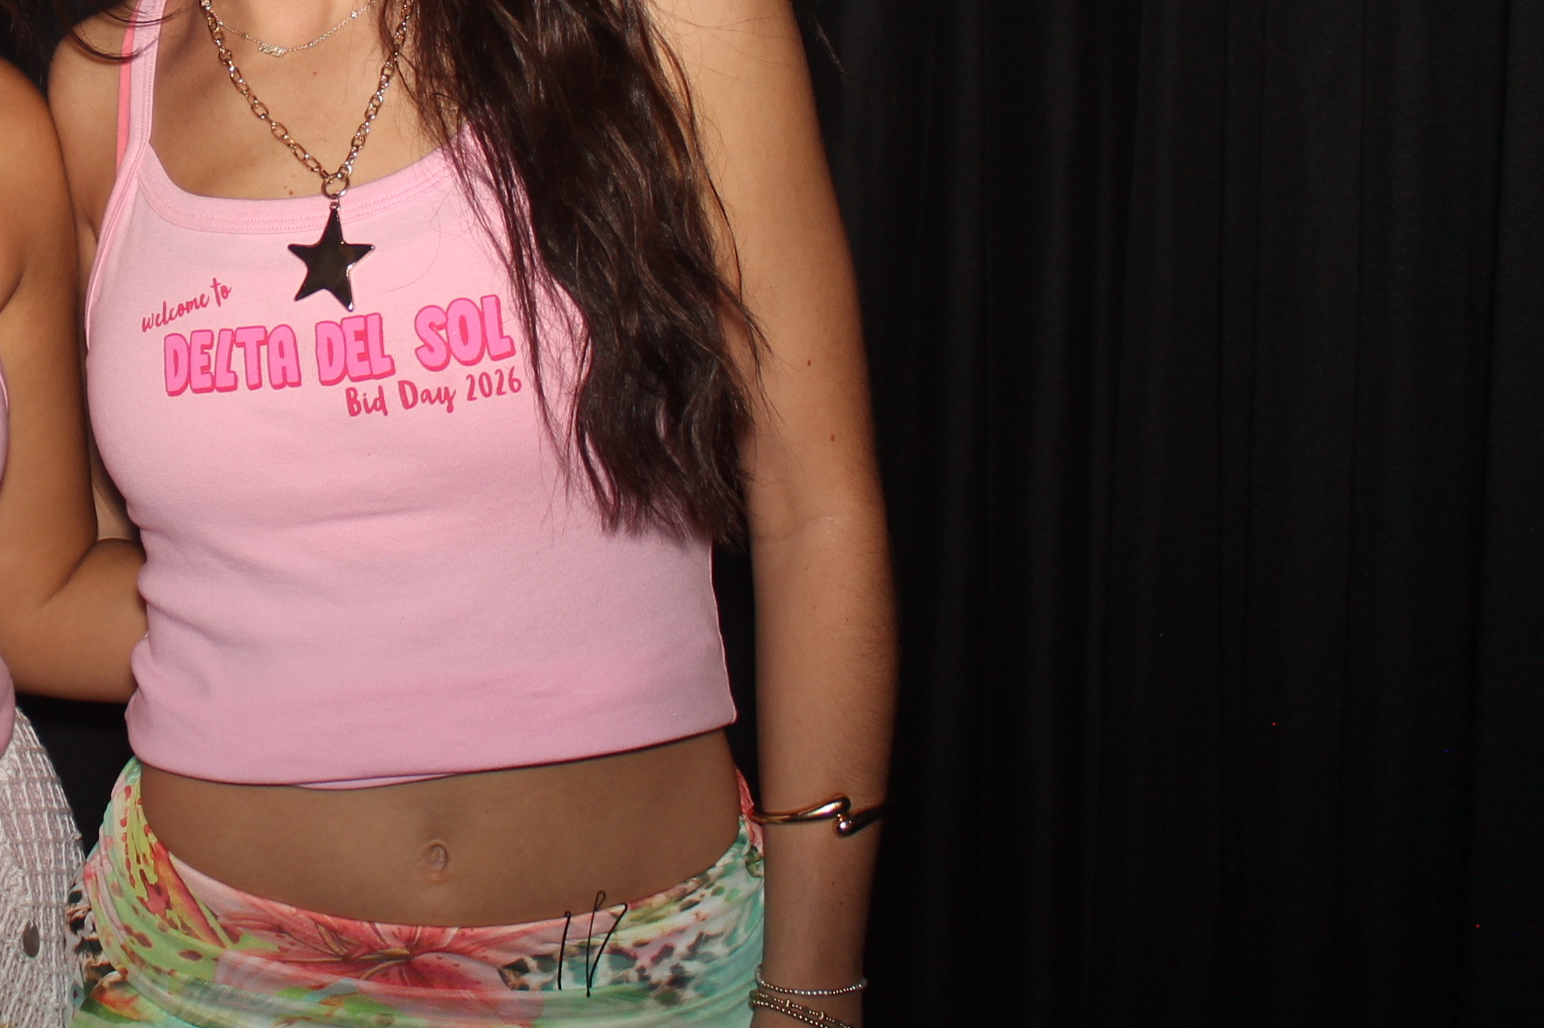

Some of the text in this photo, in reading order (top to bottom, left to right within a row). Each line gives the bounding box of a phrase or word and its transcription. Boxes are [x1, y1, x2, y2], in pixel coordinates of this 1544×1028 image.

[141, 277, 232, 333] welcome to
[163, 294, 516, 397] DELTA DEL SOL
[345, 366, 522, 417] Bid Day 2026
